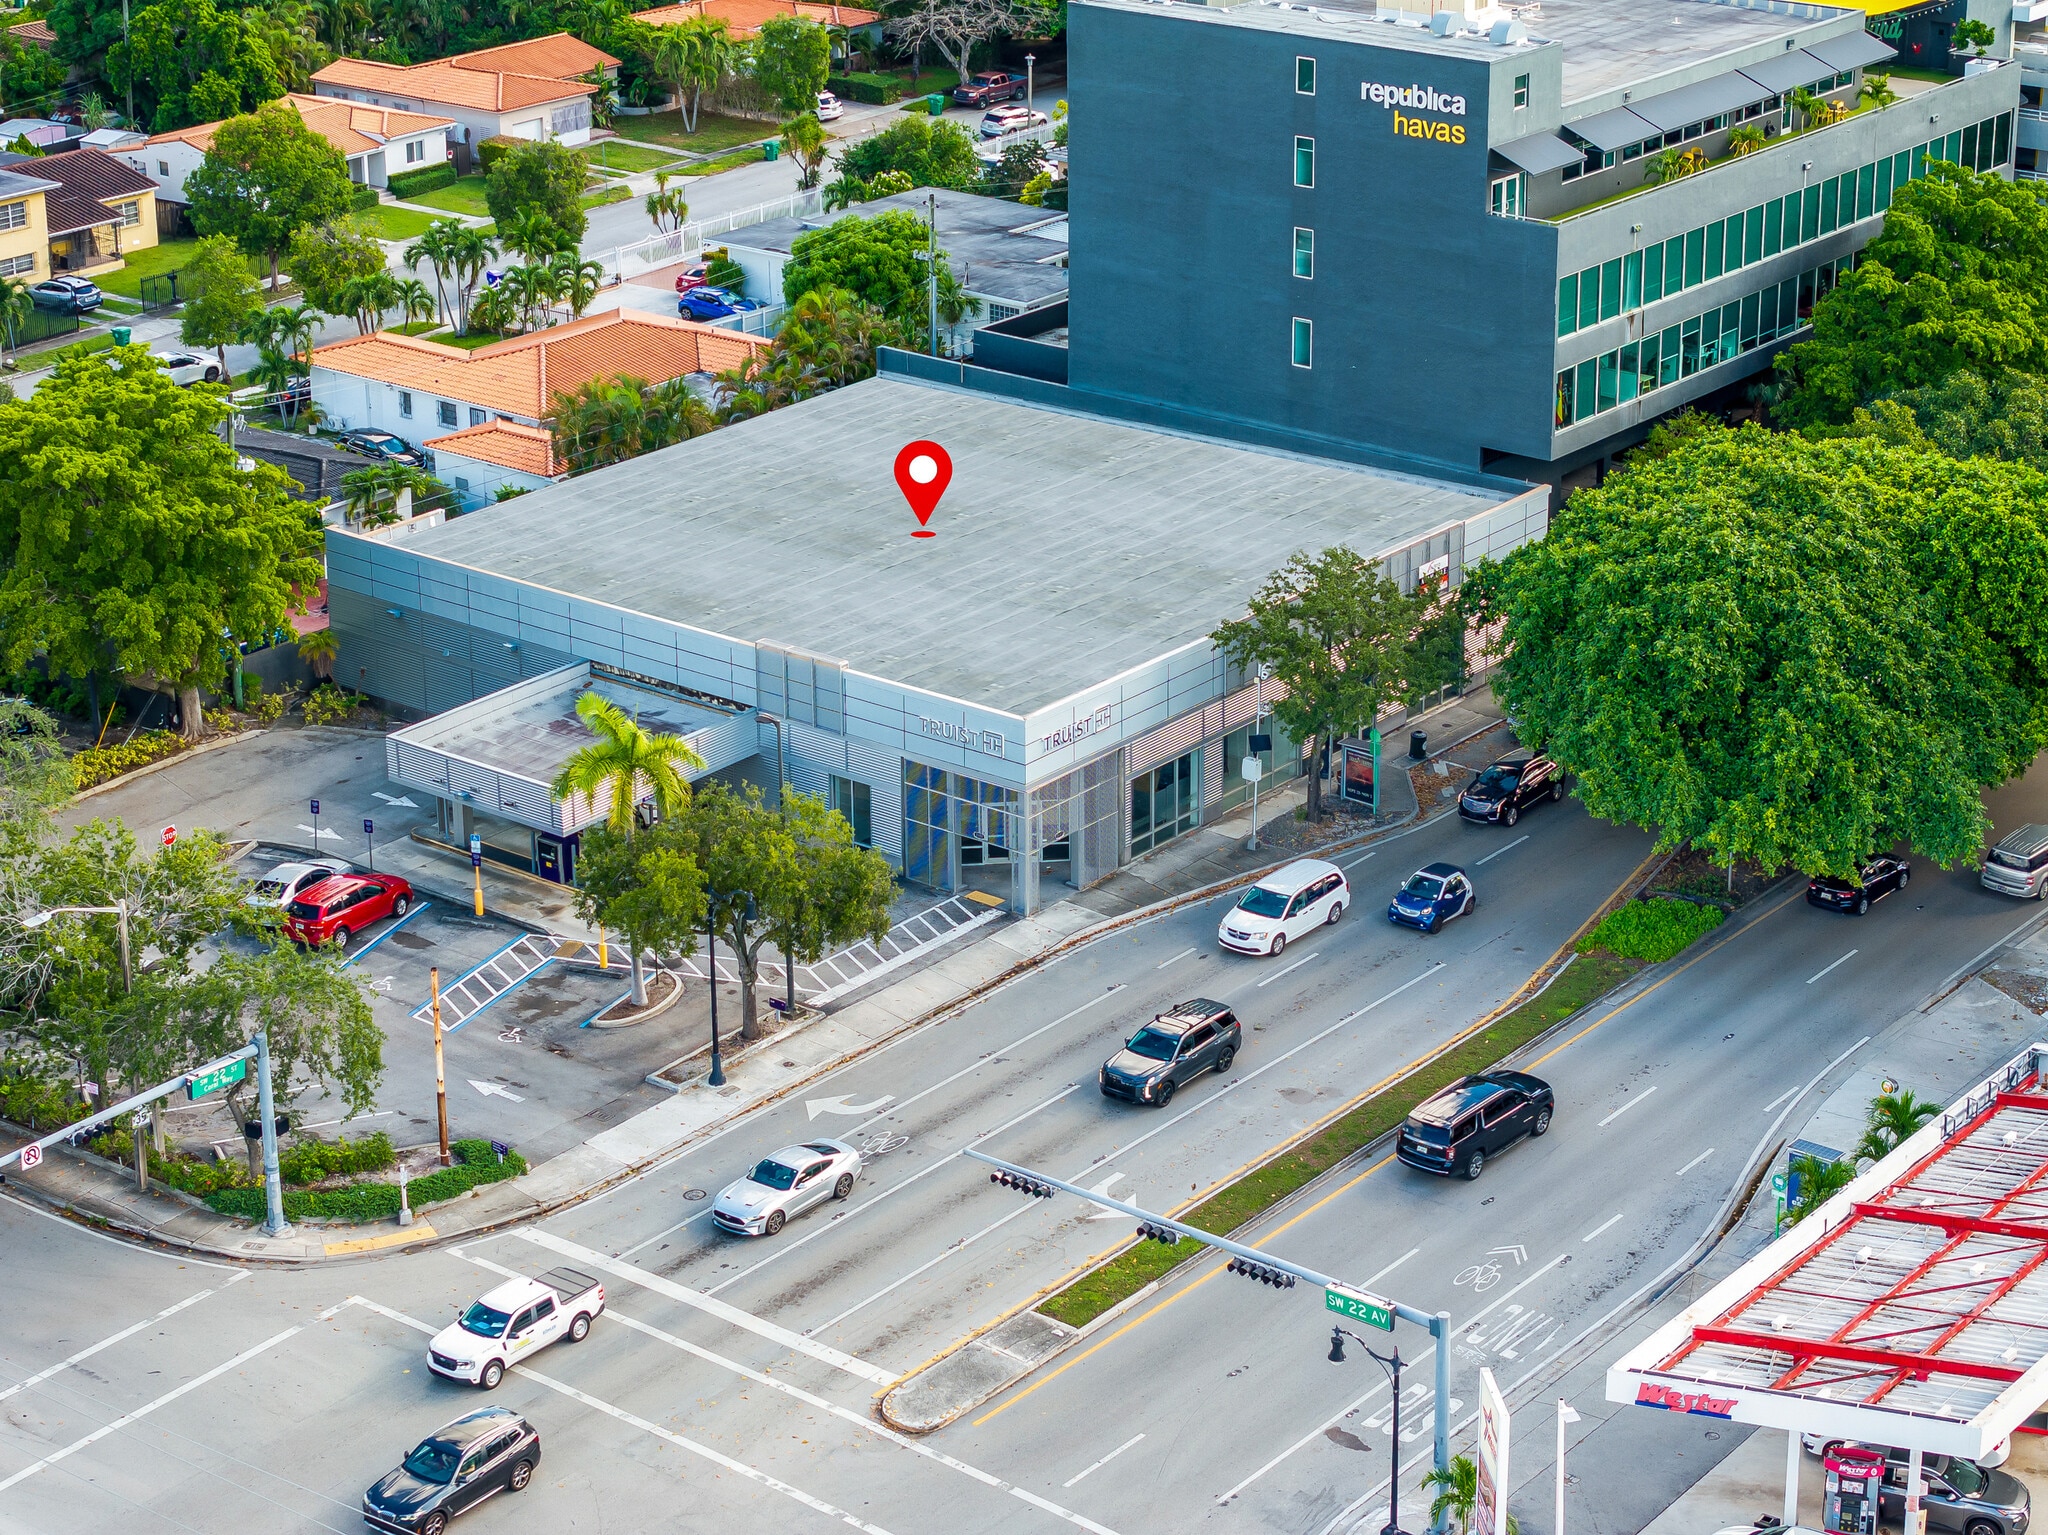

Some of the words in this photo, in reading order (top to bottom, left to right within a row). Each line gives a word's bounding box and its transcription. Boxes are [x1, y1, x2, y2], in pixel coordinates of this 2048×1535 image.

[1393, 109, 1466, 144] havas
[919, 716, 981, 747] TRUIST
[1042, 717, 1092, 752] TRUIST
[161, 830, 176, 841] STOP
[199, 1077, 209, 1086] SW
[212, 1068, 226, 1083] 22
[230, 1064, 238, 1073] ST
[203, 1080, 219, 1092] Coral
[221, 1076, 234, 1084] Way
[1328, 1294, 1344, 1309] SW
[1348, 1300, 1367, 1319] 22
[1371, 1310, 1387, 1324] AV
[1637, 1382, 1739, 1415] Westar
[1838, 1464, 1869, 1475] Westar
